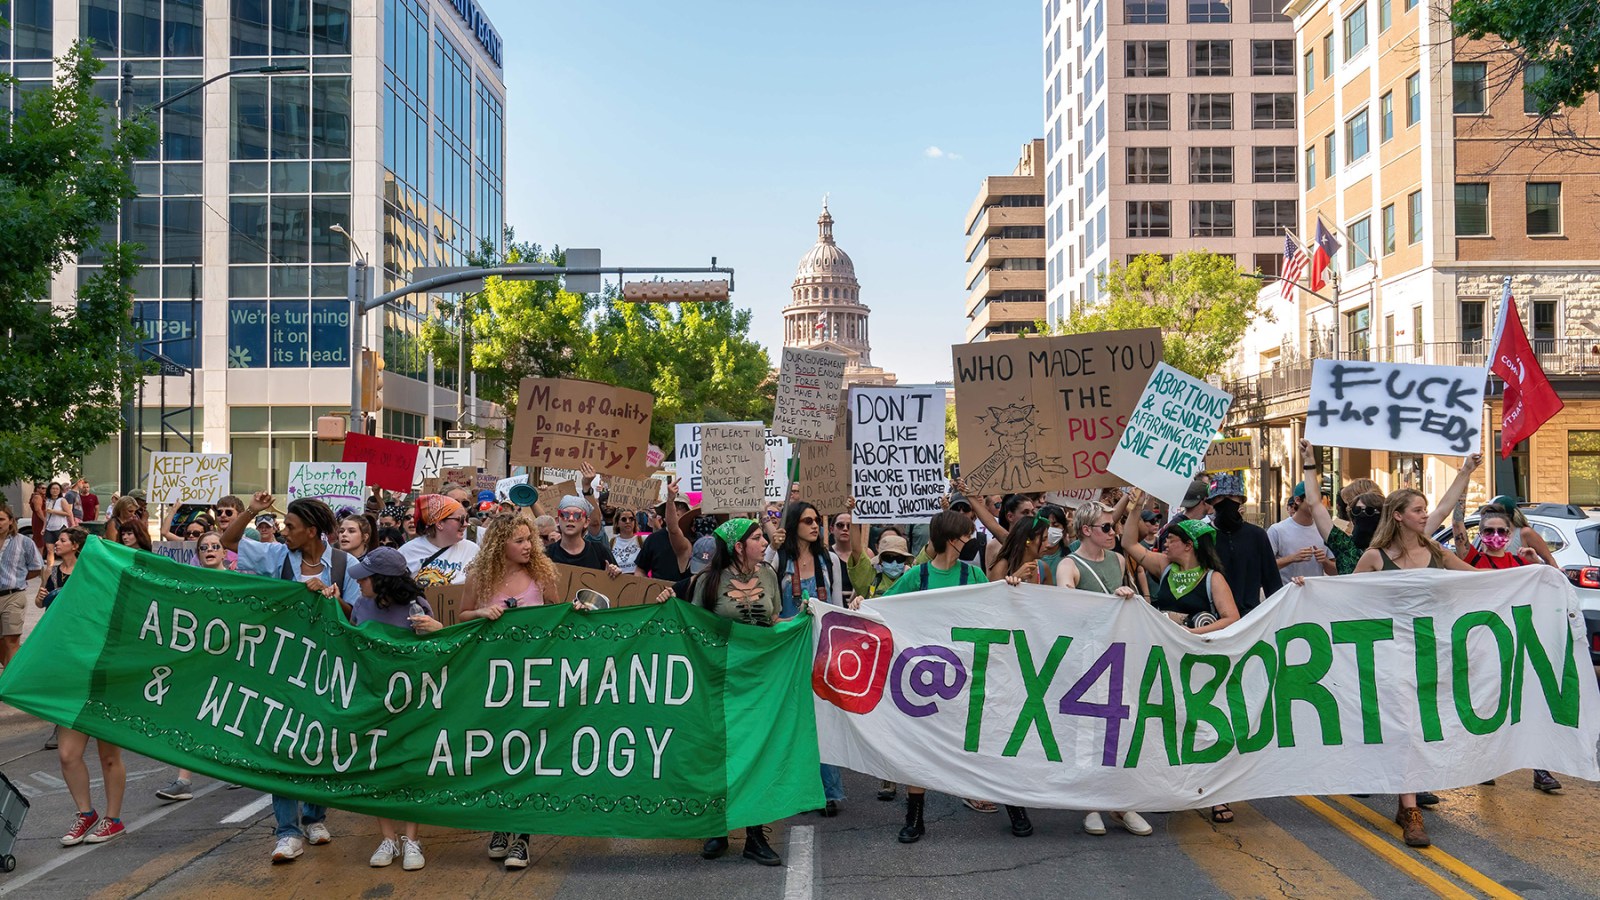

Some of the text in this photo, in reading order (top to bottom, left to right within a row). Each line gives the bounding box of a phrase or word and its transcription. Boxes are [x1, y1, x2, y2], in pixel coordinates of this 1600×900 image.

[475, 11, 502, 69] BANK
[231, 308, 349, 327] We're turning
[274, 328, 308, 343] it on
[274, 347, 346, 362] its head.
[786, 350, 804, 362] OUR
[957, 340, 1155, 383] WHO MADE YOU
[783, 364, 790, 372] IS
[795, 364, 816, 374] BOLD
[781, 374, 839, 390] TO FORCE YOU
[1329, 364, 1478, 413] FUCK
[780, 384, 790, 394] TO
[794, 388, 812, 398] HAVE
[1059, 386, 1112, 411] THE
[1148, 368, 1230, 420] ABORTIONS
[578, 396, 597, 415] of
[598, 398, 648, 424] Quality
[779, 396, 796, 406] BUT
[800, 400, 815, 408] TOO
[856, 394, 932, 424] DON'T
[775, 414, 796, 424] MAKE
[779, 406, 788, 414] TO
[791, 408, 821, 418] ENSURE
[1142, 394, 1218, 437] & GENDER-
[536, 414, 620, 438] Do not fear
[704, 428, 718, 438] AT
[722, 428, 750, 438] LEAST
[756, 428, 764, 438] IN
[782, 426, 812, 438] RECESS
[814, 431, 834, 440] ALIVE
[878, 424, 918, 442] LIKE
[1130, 409, 1208, 456] AFFIRMING CARE
[1307, 400, 1380, 427] the
[1387, 404, 1479, 453] FEDS
[706, 442, 766, 452] AMERICA YOU
[852, 442, 944, 466] ABORTION?
[1120, 426, 1198, 478] SAVE LIVES
[153, 456, 230, 475] KEEP YOUR
[704, 454, 750, 466] CAN STILL
[291, 464, 357, 483] Abortion
[804, 463, 836, 480] WOMB
[854, 468, 904, 484] IGNORE
[908, 468, 943, 482] THEM
[153, 474, 218, 488] LAWS OFF
[302, 480, 364, 496] Essential
[744, 476, 752, 484] IF
[818, 481, 841, 494] FUCK
[152, 488, 171, 502] MY
[710, 486, 756, 497] YOU GET
[854, 483, 945, 498] LIKE YOU IGNORE
[716, 497, 762, 507] PREGNANT
[854, 496, 943, 516] SCHOOL SHOOTINGS
[138, 600, 694, 714] ABORTION ON DEMAND
[890, 604, 1580, 768] @TX4ABORTION
[143, 664, 674, 780] & WITHOUT APOLOGY
